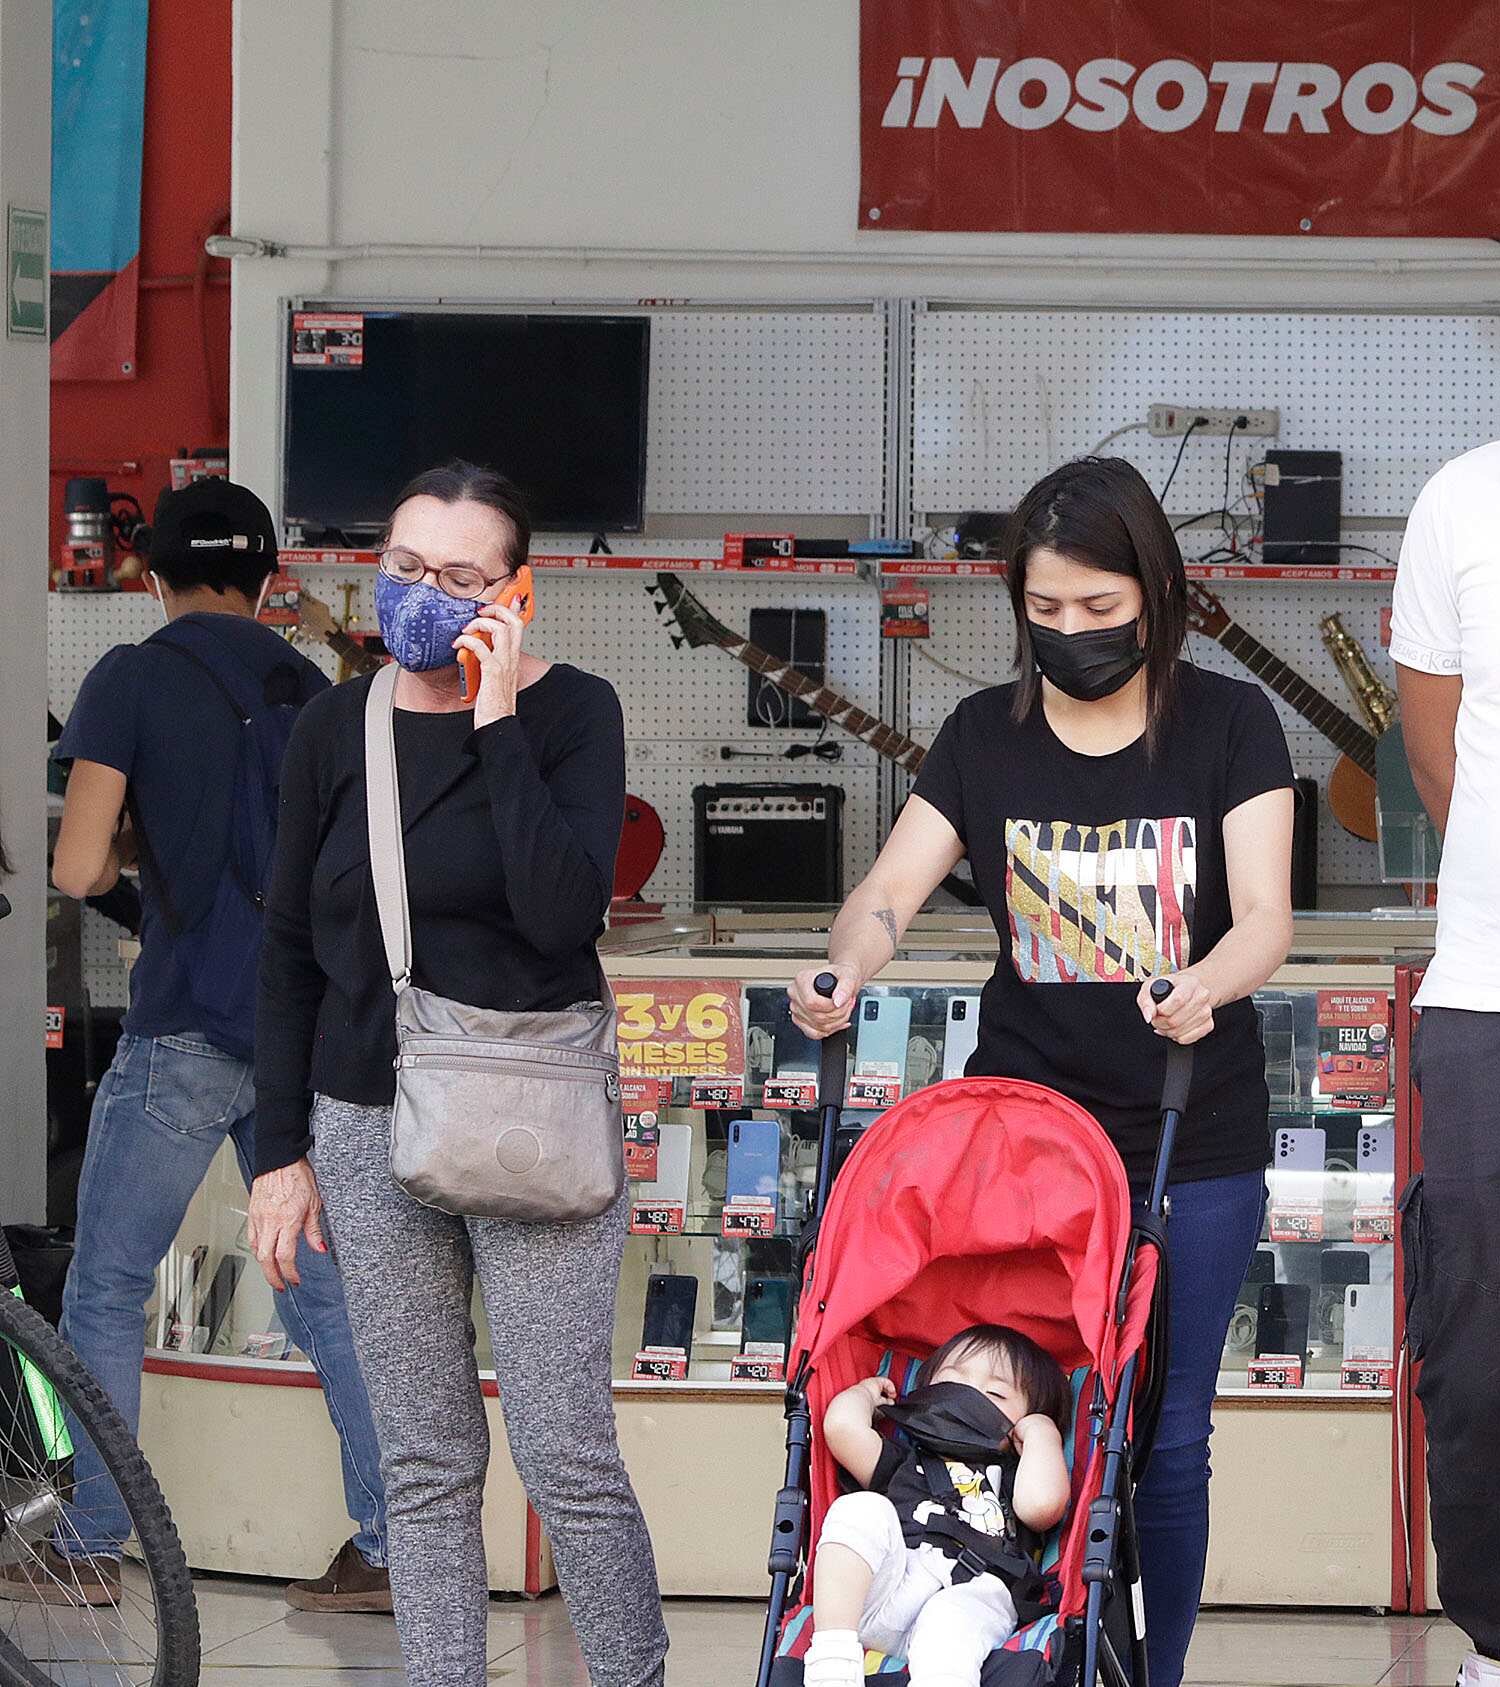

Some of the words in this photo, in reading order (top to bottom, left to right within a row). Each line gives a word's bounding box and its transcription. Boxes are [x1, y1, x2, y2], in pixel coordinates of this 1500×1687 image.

[881, 55, 1486, 137] ¡NOSOTROS
[642, 560, 694, 570] ACEPTAMOS
[899, 564, 951, 573] ACEPTAMOS
[1280, 570, 1333, 579] ACEPTAMOS
[718, 826, 744, 834] YAMAHA
[616, 993, 656, 1040] 3
[659, 1004, 684, 1031] y
[686, 992, 729, 1040] 6
[1338, 1028, 1367, 1042] FELIZ
[619, 1041, 729, 1064] MESES
[1338, 1042, 1367, 1052] NAVIDAD
[708, 1089, 728, 1100] 480
[780, 1088, 800, 1098] 480
[864, 1086, 885, 1098] 600
[648, 1211, 668, 1223] 480
[1287, 1217, 1307, 1230] 420
[1369, 1219, 1390, 1232] 420
[650, 1363, 671, 1375] 420
[747, 1366, 768, 1377] 420
[1264, 1371, 1285, 1383] 380
[1358, 1371, 1379, 1383] 380
